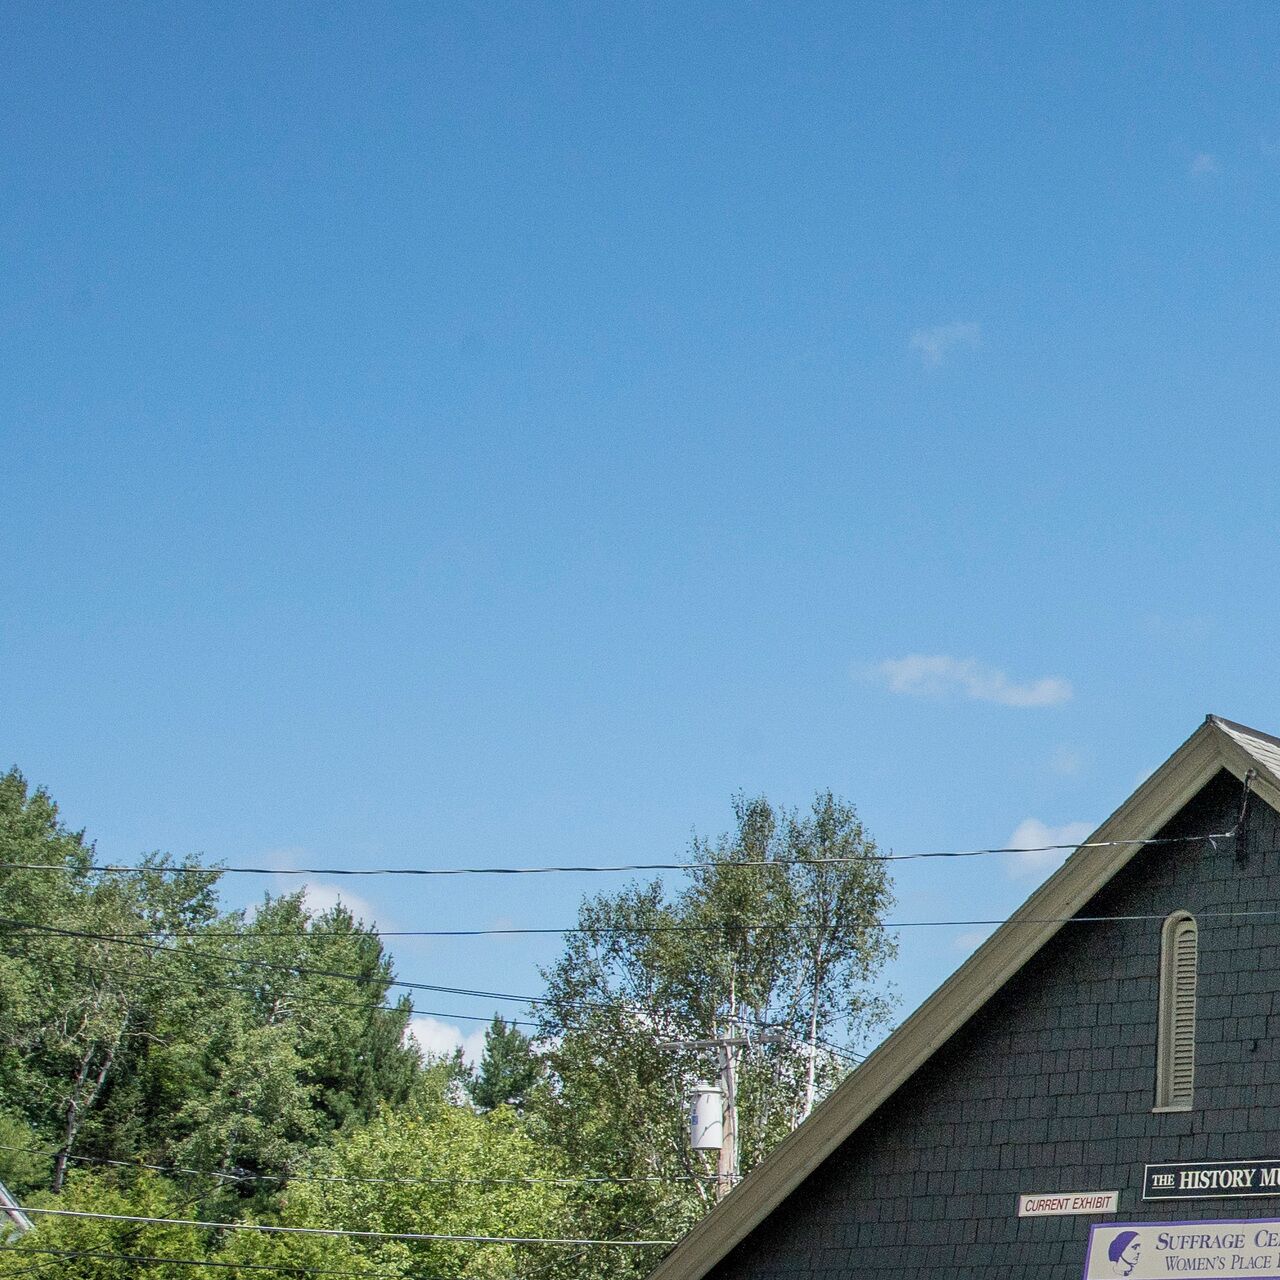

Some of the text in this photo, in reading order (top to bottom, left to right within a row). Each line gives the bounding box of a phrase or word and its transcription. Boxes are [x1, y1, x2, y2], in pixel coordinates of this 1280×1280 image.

[1152, 1174, 1175, 1187] THE
[1178, 1169, 1255, 1190] HISTORY
[1025, 1196, 1112, 1212] CURRENT EXHIBIT
[1156, 1232, 1245, 1251] SUFFRAGE
[1165, 1255, 1226, 1271] WOMEN'S
[1231, 1254, 1272, 1270] PLACE
